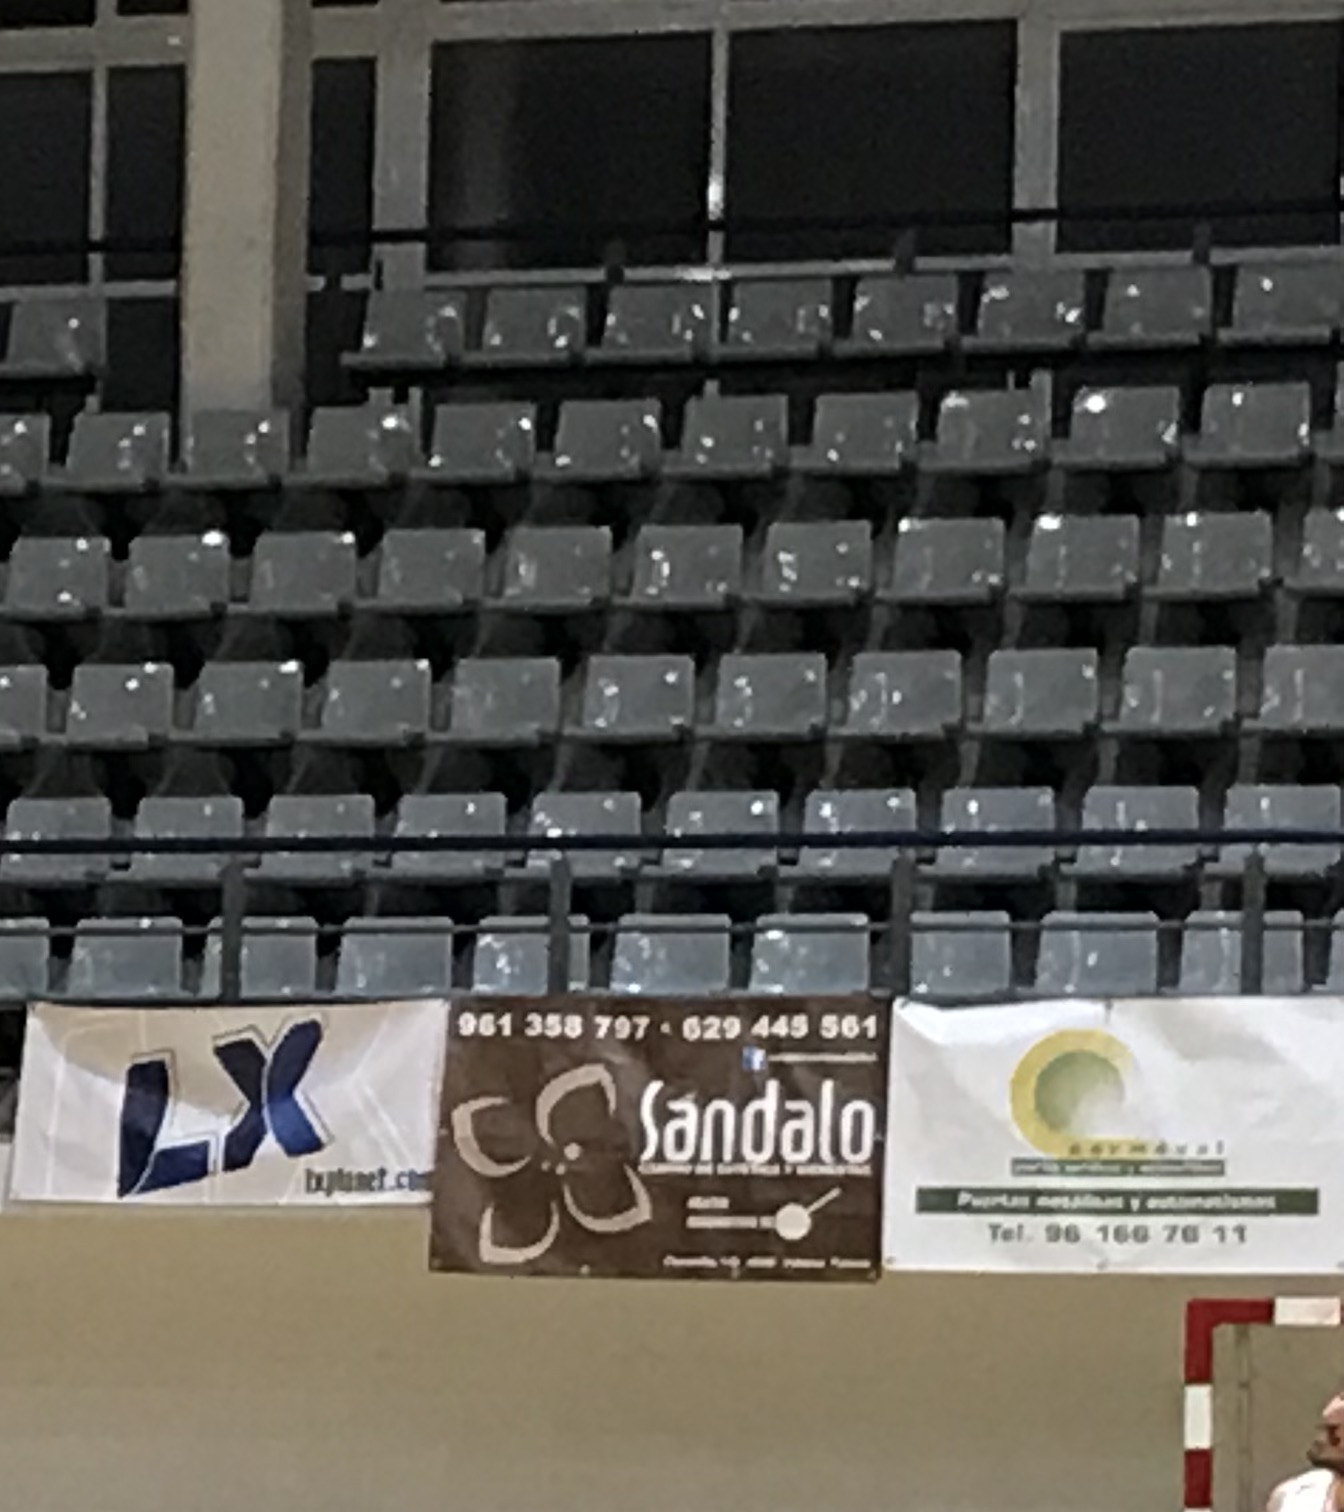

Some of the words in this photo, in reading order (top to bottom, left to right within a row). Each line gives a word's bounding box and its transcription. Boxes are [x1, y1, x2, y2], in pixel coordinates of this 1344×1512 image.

[458, 1012, 512, 1037] 961
[524, 1012, 583, 1039] 358
[594, 1014, 651, 1041] 797
[682, 1015, 741, 1042] 629
[819, 1014, 877, 1039] 561
[639, 1079, 876, 1164] Sándalo
